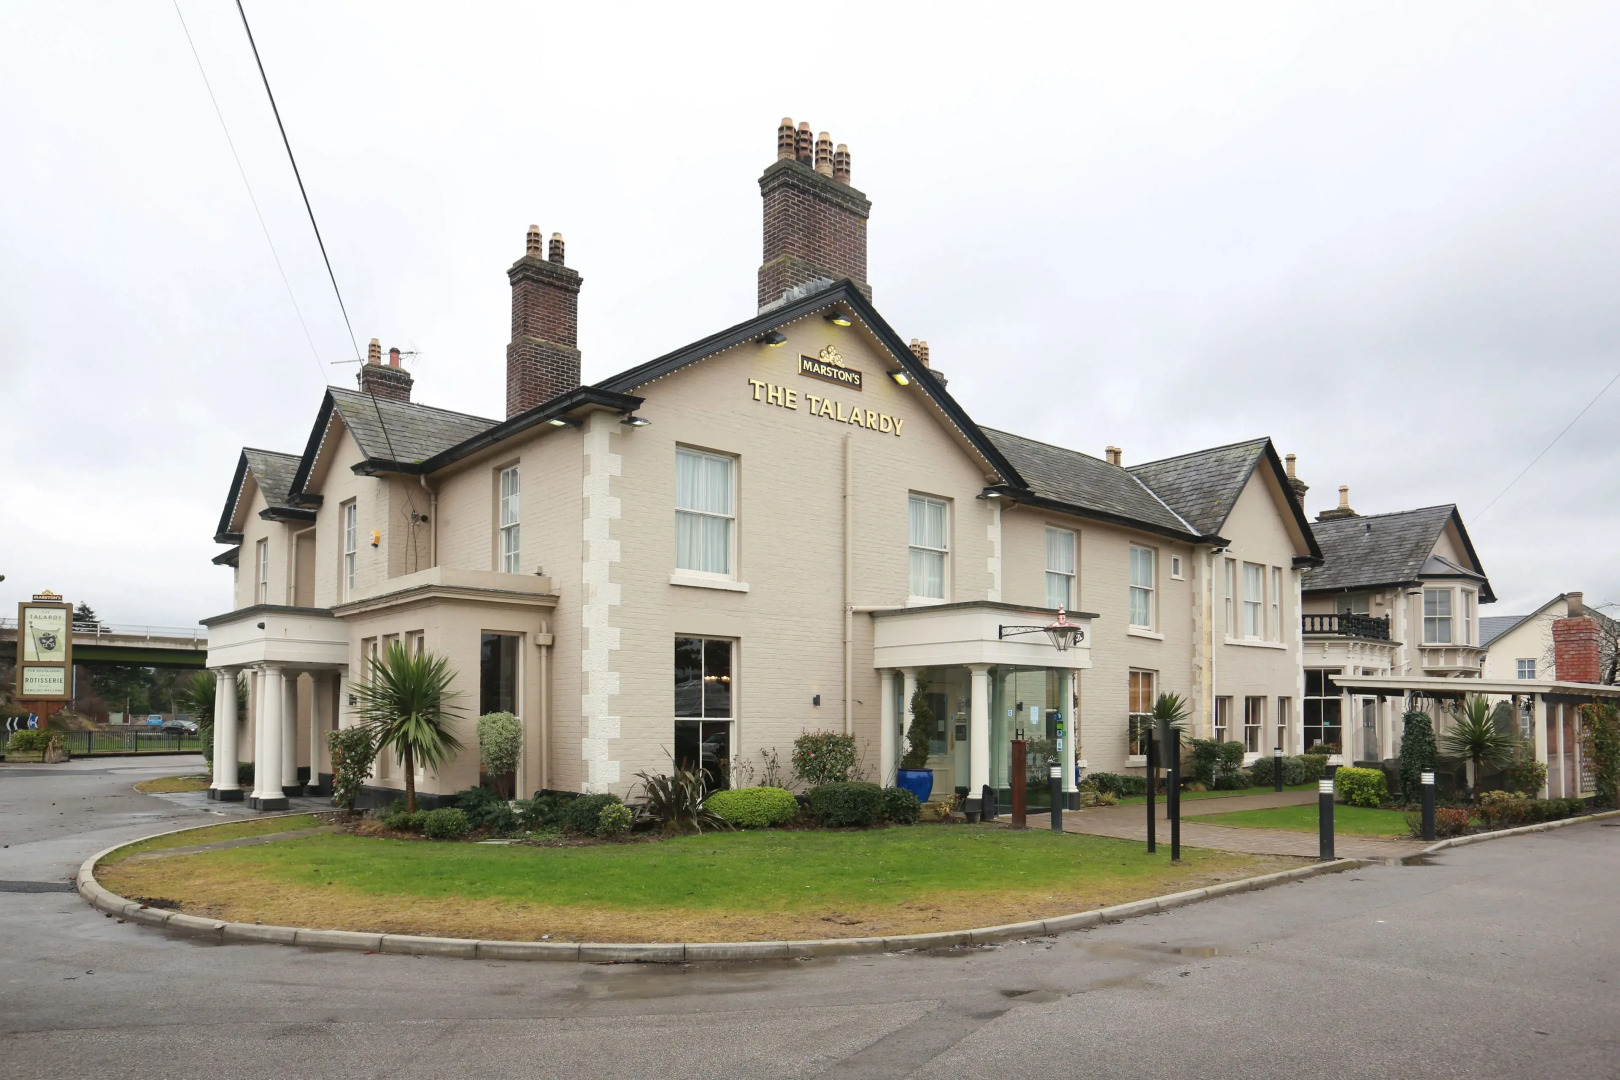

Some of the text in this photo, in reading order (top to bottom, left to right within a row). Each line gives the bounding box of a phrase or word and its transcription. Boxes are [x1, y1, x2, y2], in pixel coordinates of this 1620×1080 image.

[803, 360, 860, 385] MARSTON'S
[748, 378, 904, 437] THE TALARDY
